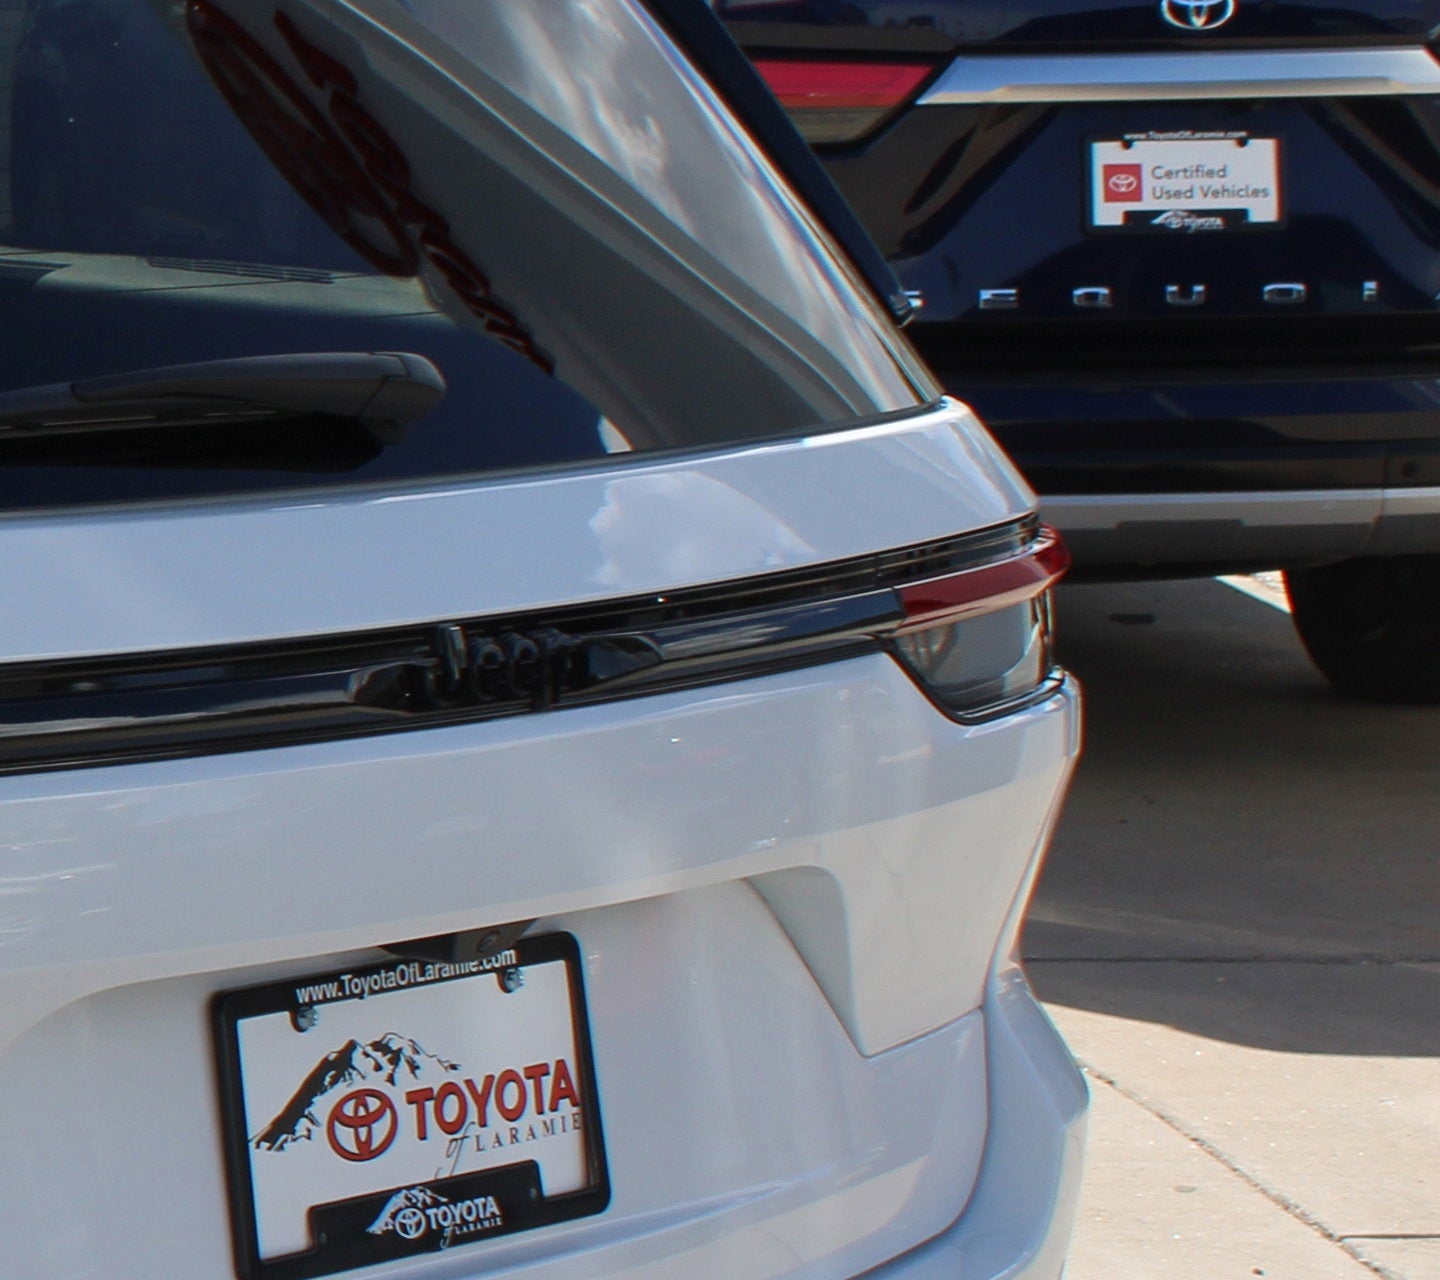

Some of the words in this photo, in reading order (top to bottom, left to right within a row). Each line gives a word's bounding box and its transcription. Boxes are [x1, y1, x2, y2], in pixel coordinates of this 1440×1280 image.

[1150, 164, 1228, 180] Certified
[1151, 186, 1195, 200] Used
[1199, 185, 1270, 200] Vehicles
[404, 1058, 581, 1141] TOYOTA
[473, 1112, 582, 1153] LARAMIE
[425, 1195, 500, 1230] TOYOTA
